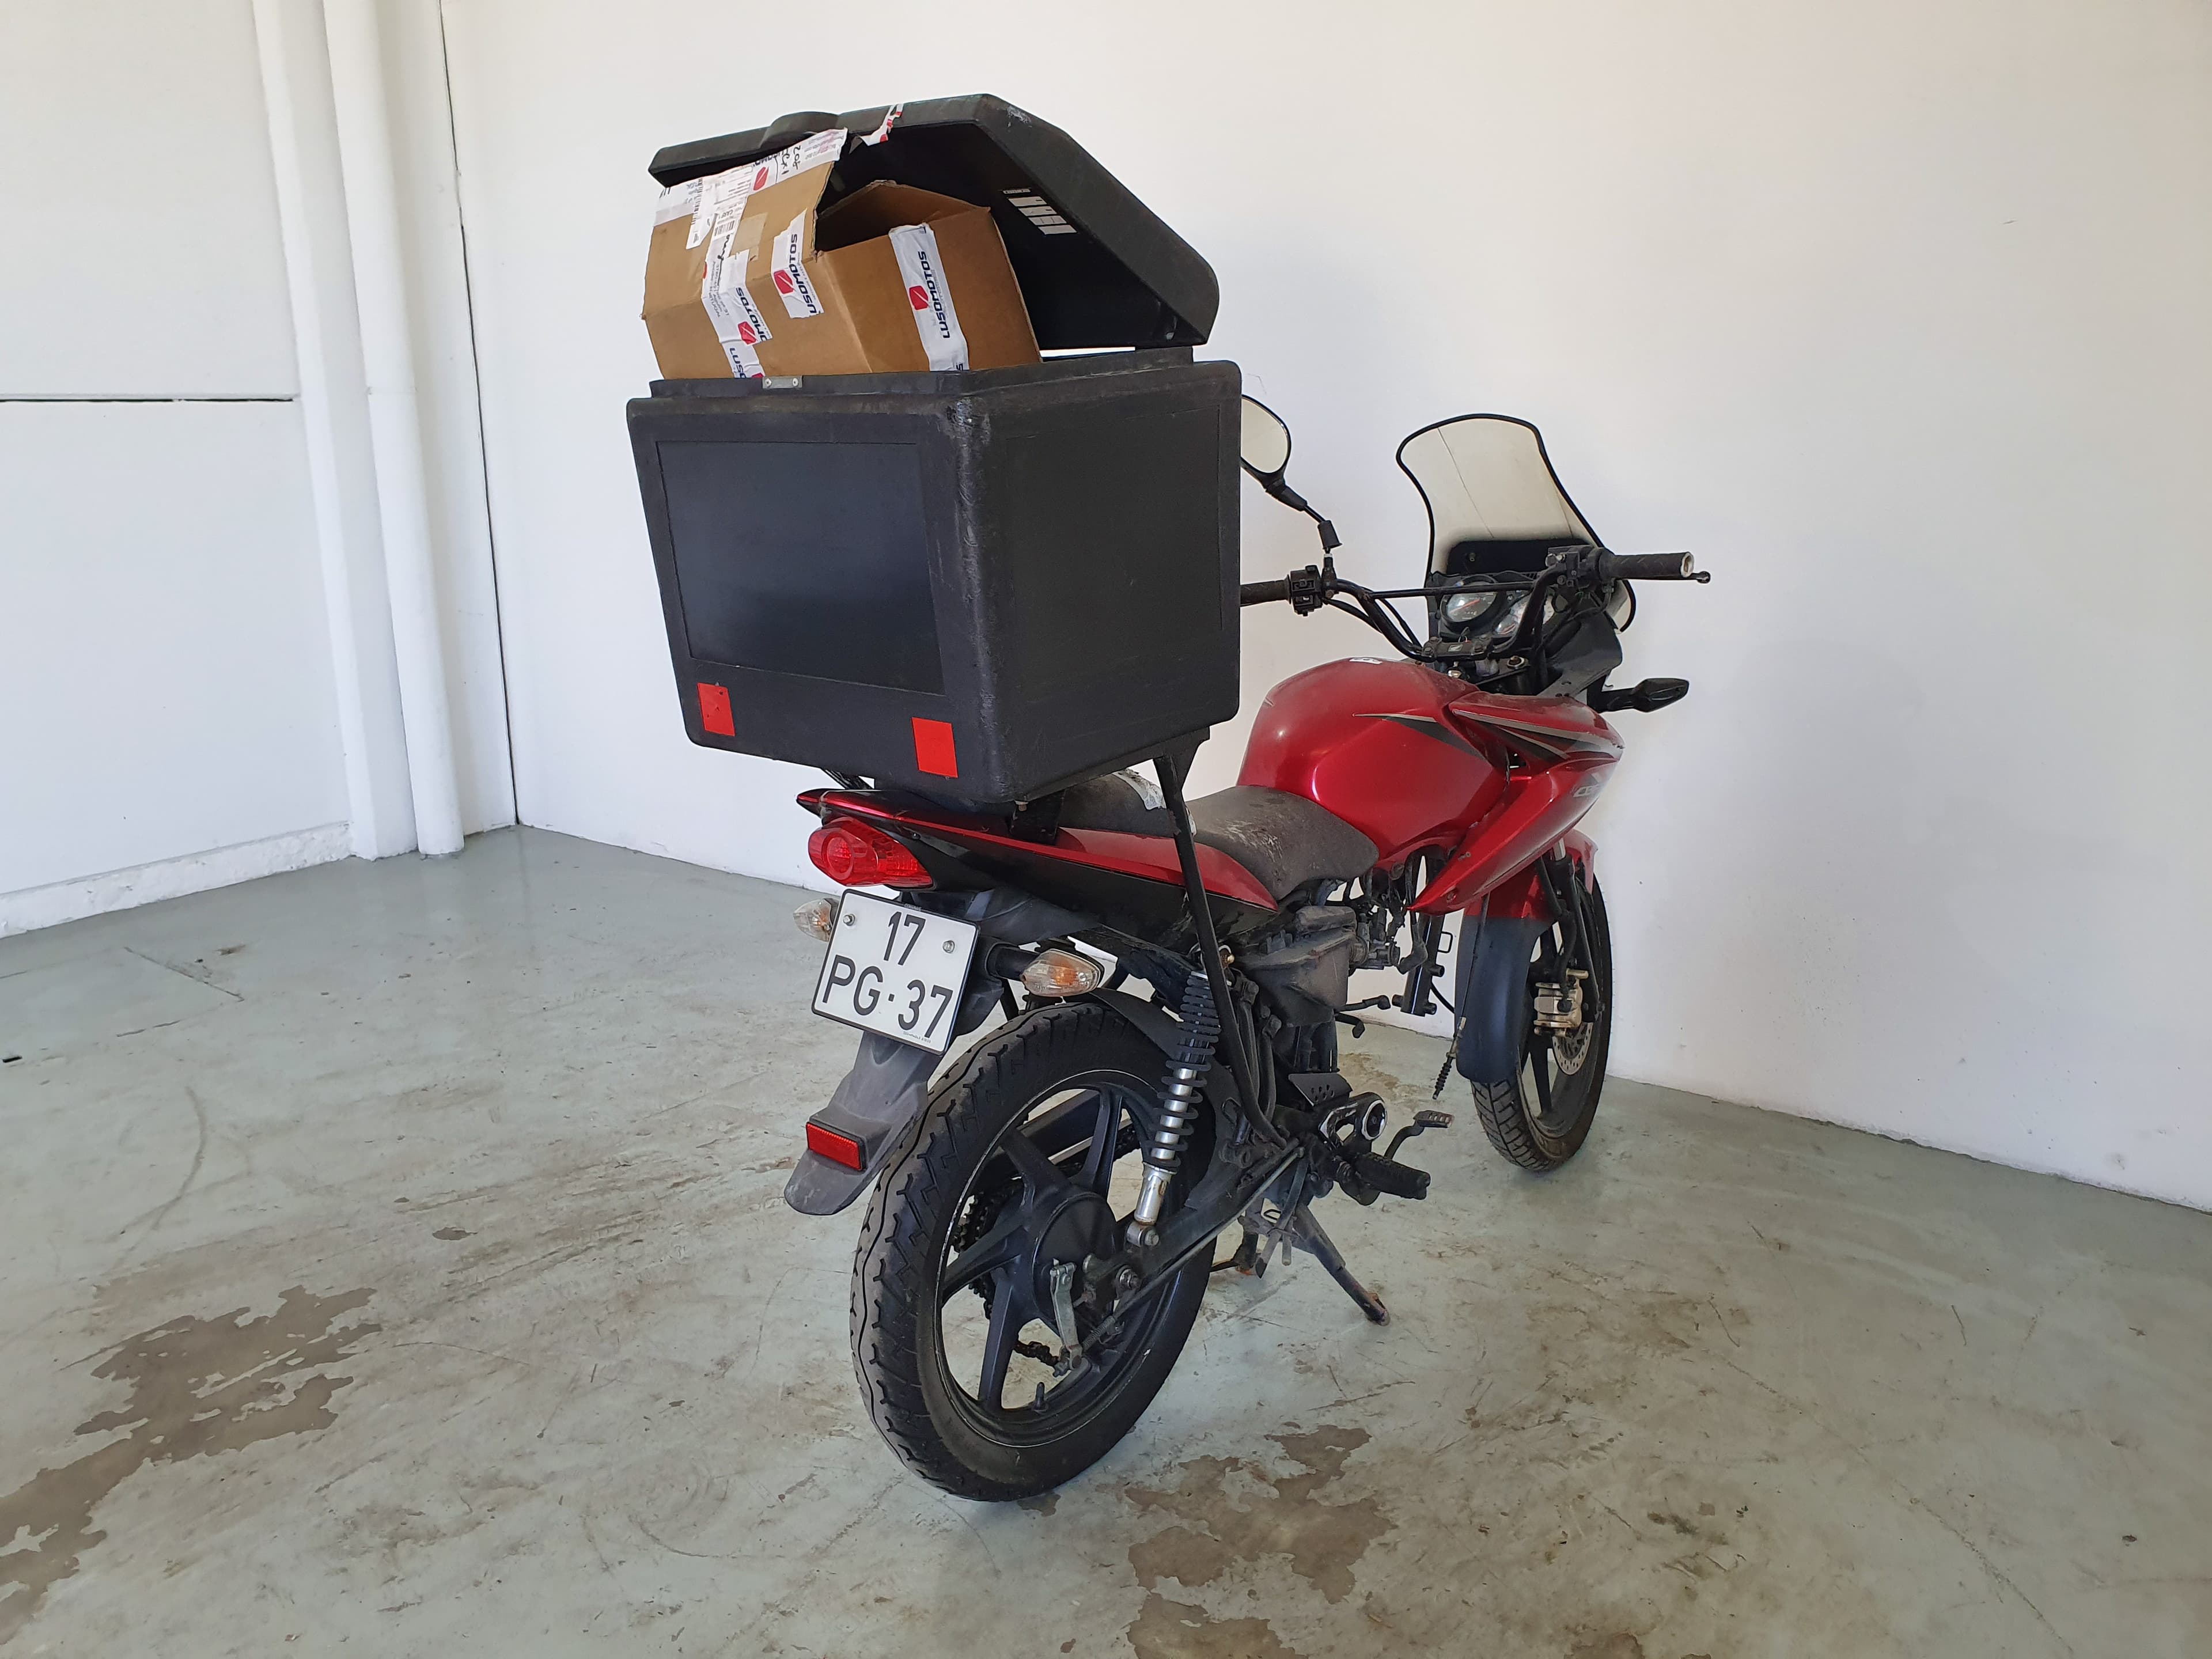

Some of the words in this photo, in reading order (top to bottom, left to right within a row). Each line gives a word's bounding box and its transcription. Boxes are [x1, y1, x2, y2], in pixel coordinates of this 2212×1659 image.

[789, 233, 821, 317] USOMOTOS
[918, 251, 950, 339] LUSOMOTOS
[883, 911, 926, 966] 17
